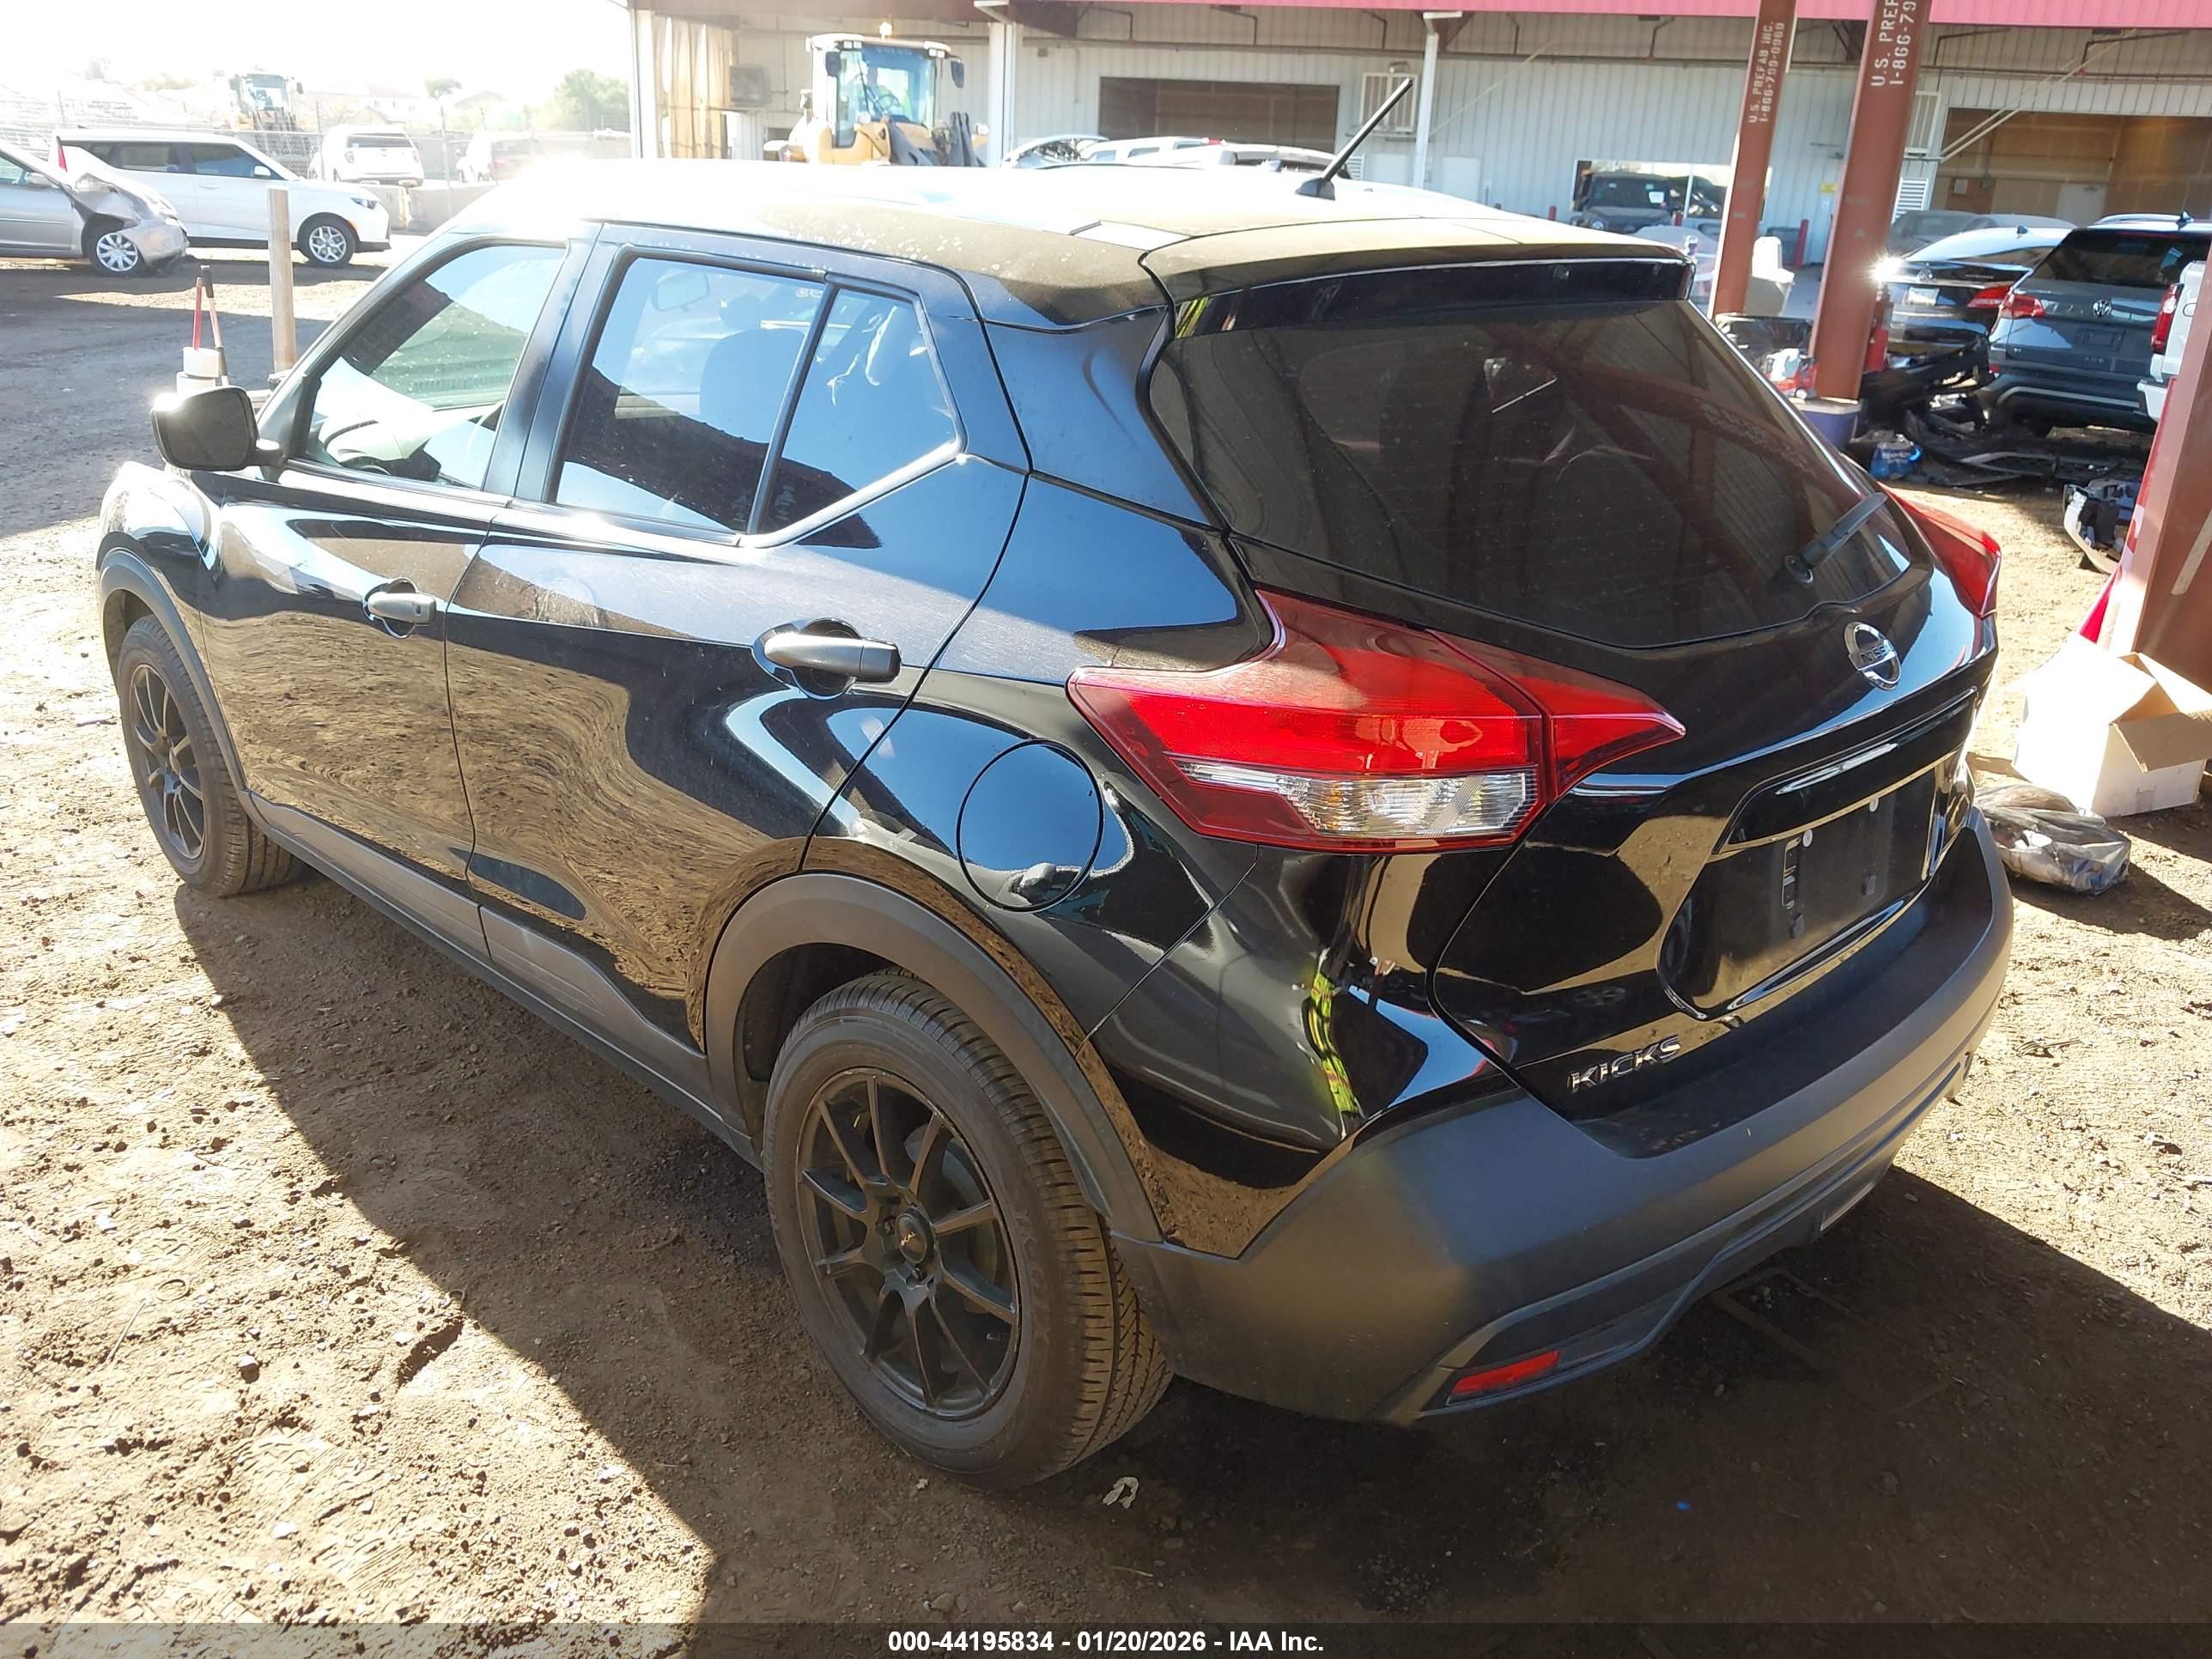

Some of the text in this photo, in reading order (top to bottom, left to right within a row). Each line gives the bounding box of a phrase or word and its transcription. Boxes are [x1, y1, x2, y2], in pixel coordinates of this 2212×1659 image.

[1889, 1, 1917, 85] 1-866-79
[1752, 49, 1769, 95] PREFAB
[1869, 52, 1891, 86] U.S.
[1567, 1035, 1681, 1092] KICKS
